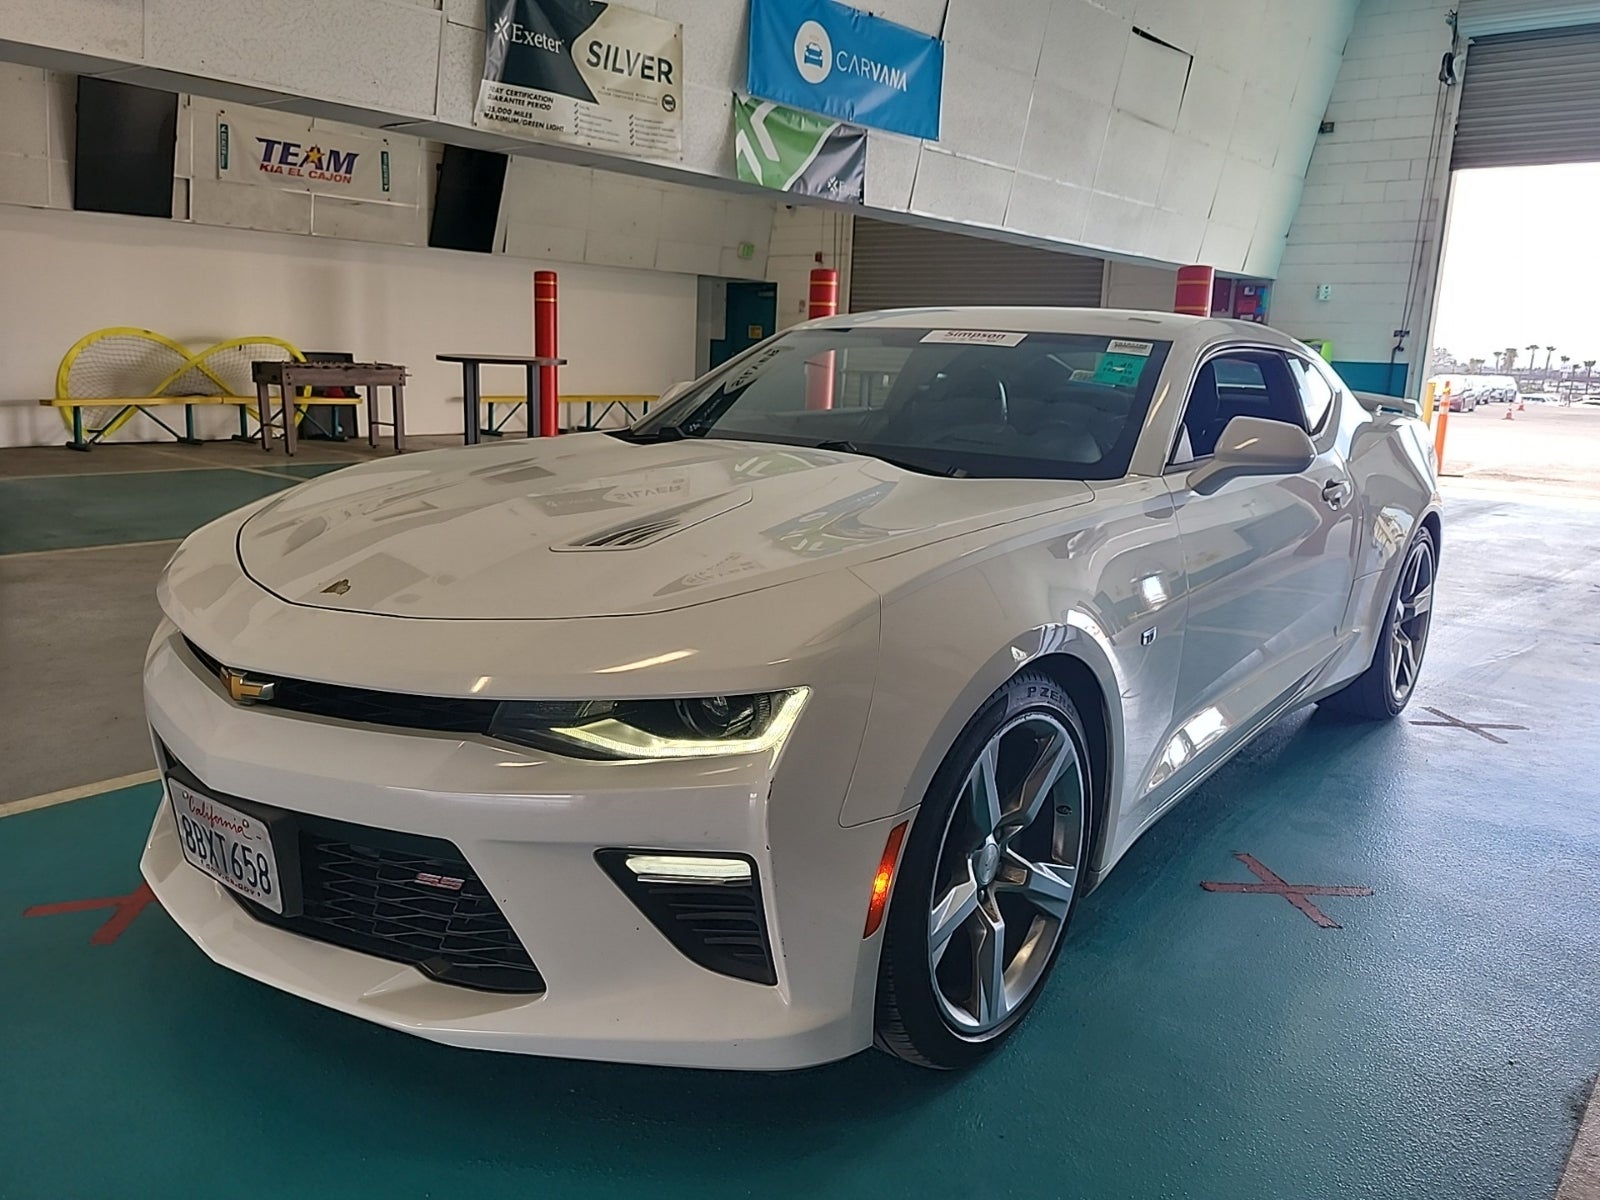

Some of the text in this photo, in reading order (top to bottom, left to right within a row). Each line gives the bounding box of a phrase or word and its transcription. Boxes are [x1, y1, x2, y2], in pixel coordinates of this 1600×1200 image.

[511, 23, 563, 54] Exeter
[586, 40, 673, 85] SILVER
[836, 50, 907, 92] CARVANA
[505, 89, 554, 103] CERTIFICATION
[513, 110, 533, 119] MILES
[527, 101, 552, 111] PERIOD
[546, 124, 565, 132] LIGHT
[255, 137, 360, 175] TEAM
[259, 163, 352, 184] KIA EL CAJON
[944, 331, 1007, 340] Simpson
[1027, 687, 1037, 698] P
[189, 795, 252, 840] California
[182, 814, 271, 895] 8BXT658
[415, 873, 466, 890] SS
